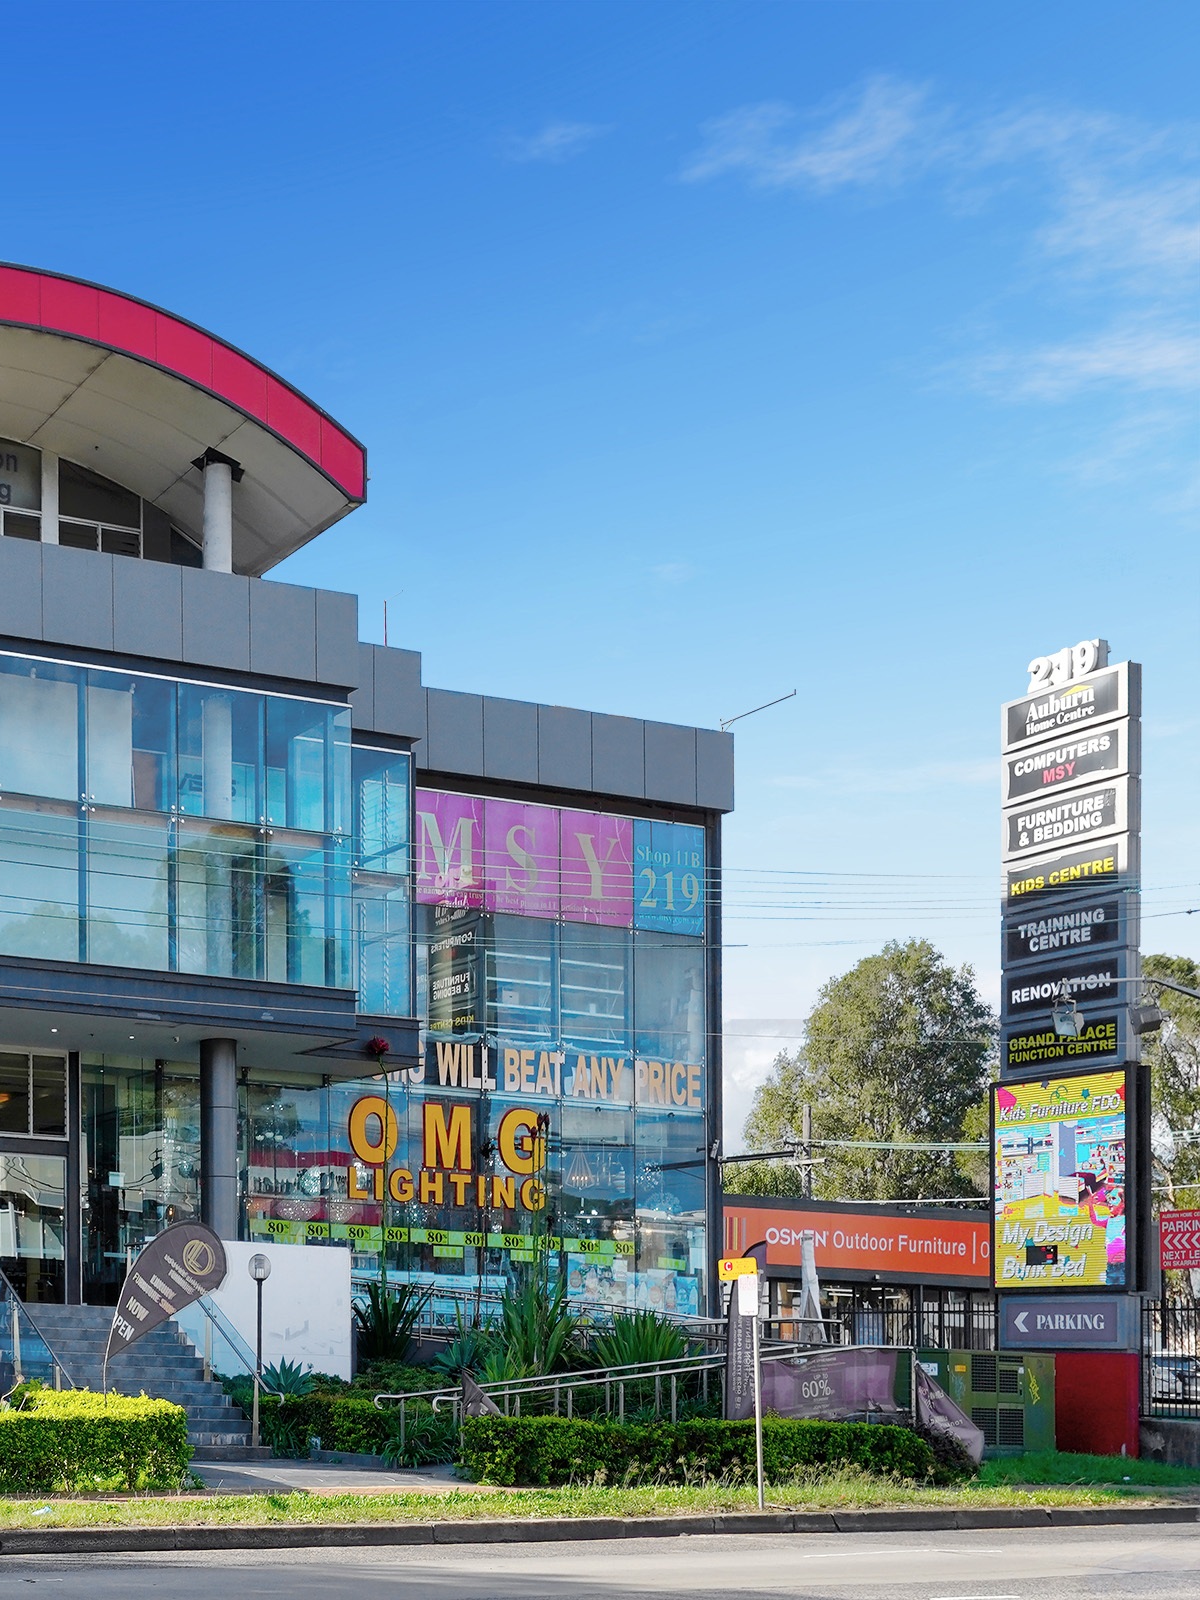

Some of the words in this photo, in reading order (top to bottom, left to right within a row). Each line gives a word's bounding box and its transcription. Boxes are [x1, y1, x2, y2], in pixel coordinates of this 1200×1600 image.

[1027, 639, 1100, 693] 219
[1025, 686, 1095, 724] Auburn
[1026, 717, 1055, 736] Home
[1056, 704, 1095, 725] Centre
[1014, 736, 1110, 777] COMPUTERS
[1043, 762, 1075, 784] MSY
[1017, 795, 1104, 831] FURNITURE
[1019, 832, 1029, 847] &
[1034, 812, 1102, 842] BEDDING
[637, 845, 670, 867] Shop
[677, 850, 700, 868] 11B
[640, 868, 699, 912] 219
[1011, 875, 1044, 896] KIDS
[1049, 857, 1114, 885] CENTRE
[1018, 908, 1105, 939] TRAINNING
[1029, 927, 1091, 952] CENTRE
[1009, 1033, 1055, 1051] GRAND
[1009, 1046, 1064, 1064] FUNCTION
[1067, 1038, 1116, 1056] CENTRE
[436, 1043, 496, 1090] WILL
[504, 1048, 565, 1095] BEAT
[572, 1056, 626, 1099] ANY
[635, 1060, 702, 1107] PRICE
[1000, 1105, 1026, 1122] Kids
[1029, 1098, 1088, 1119] Furniture
[348, 1095, 546, 1175] OMG
[347, 1166, 546, 1212] LIGHTING
[1002, 1222, 1029, 1248] My
[1034, 1219, 1093, 1248] Design
[1162, 1220, 1200, 1233] PARKIN
[832, 1230, 894, 1252] Outdoor
[898, 1234, 967, 1256] Furniture
[1162, 1250, 1186, 1260] NEXT
[126, 1296, 150, 1322] NOW
[1036, 1313, 1105, 1330] PARKING
[113, 1314, 135, 1341] PEN
[802, 1379, 831, 1398] 60%
